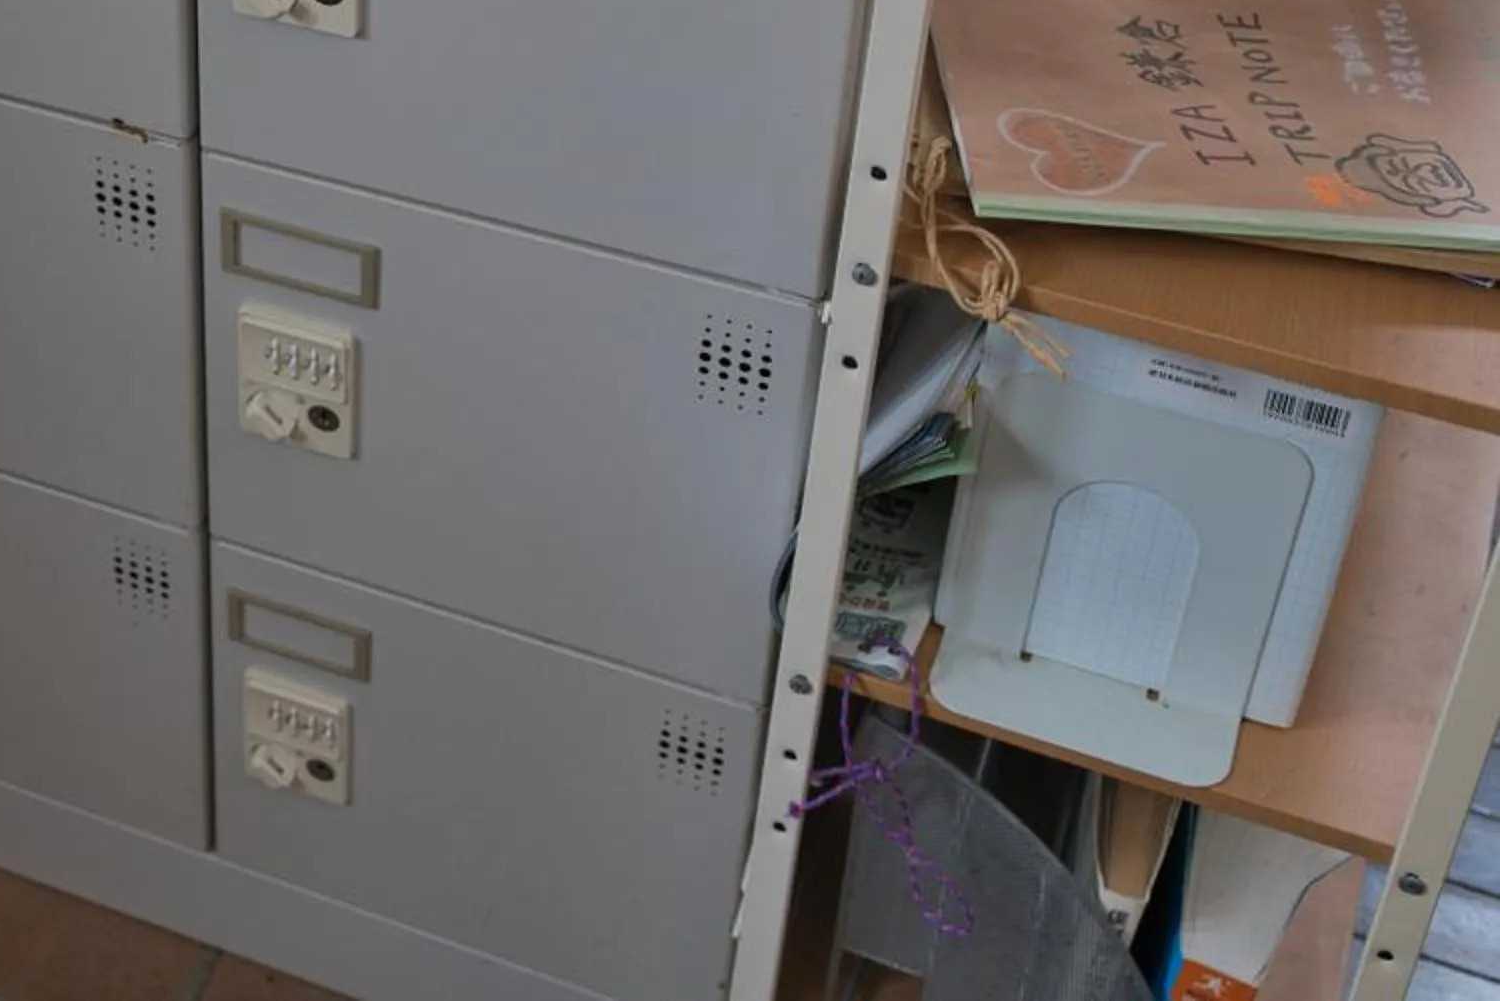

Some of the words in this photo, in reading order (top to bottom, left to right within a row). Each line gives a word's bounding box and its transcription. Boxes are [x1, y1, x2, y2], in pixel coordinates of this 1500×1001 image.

[1217, 11, 1290, 86] NOTE
[1170, 103, 1258, 167] IZA
[1247, 90, 1333, 167] TRIP
